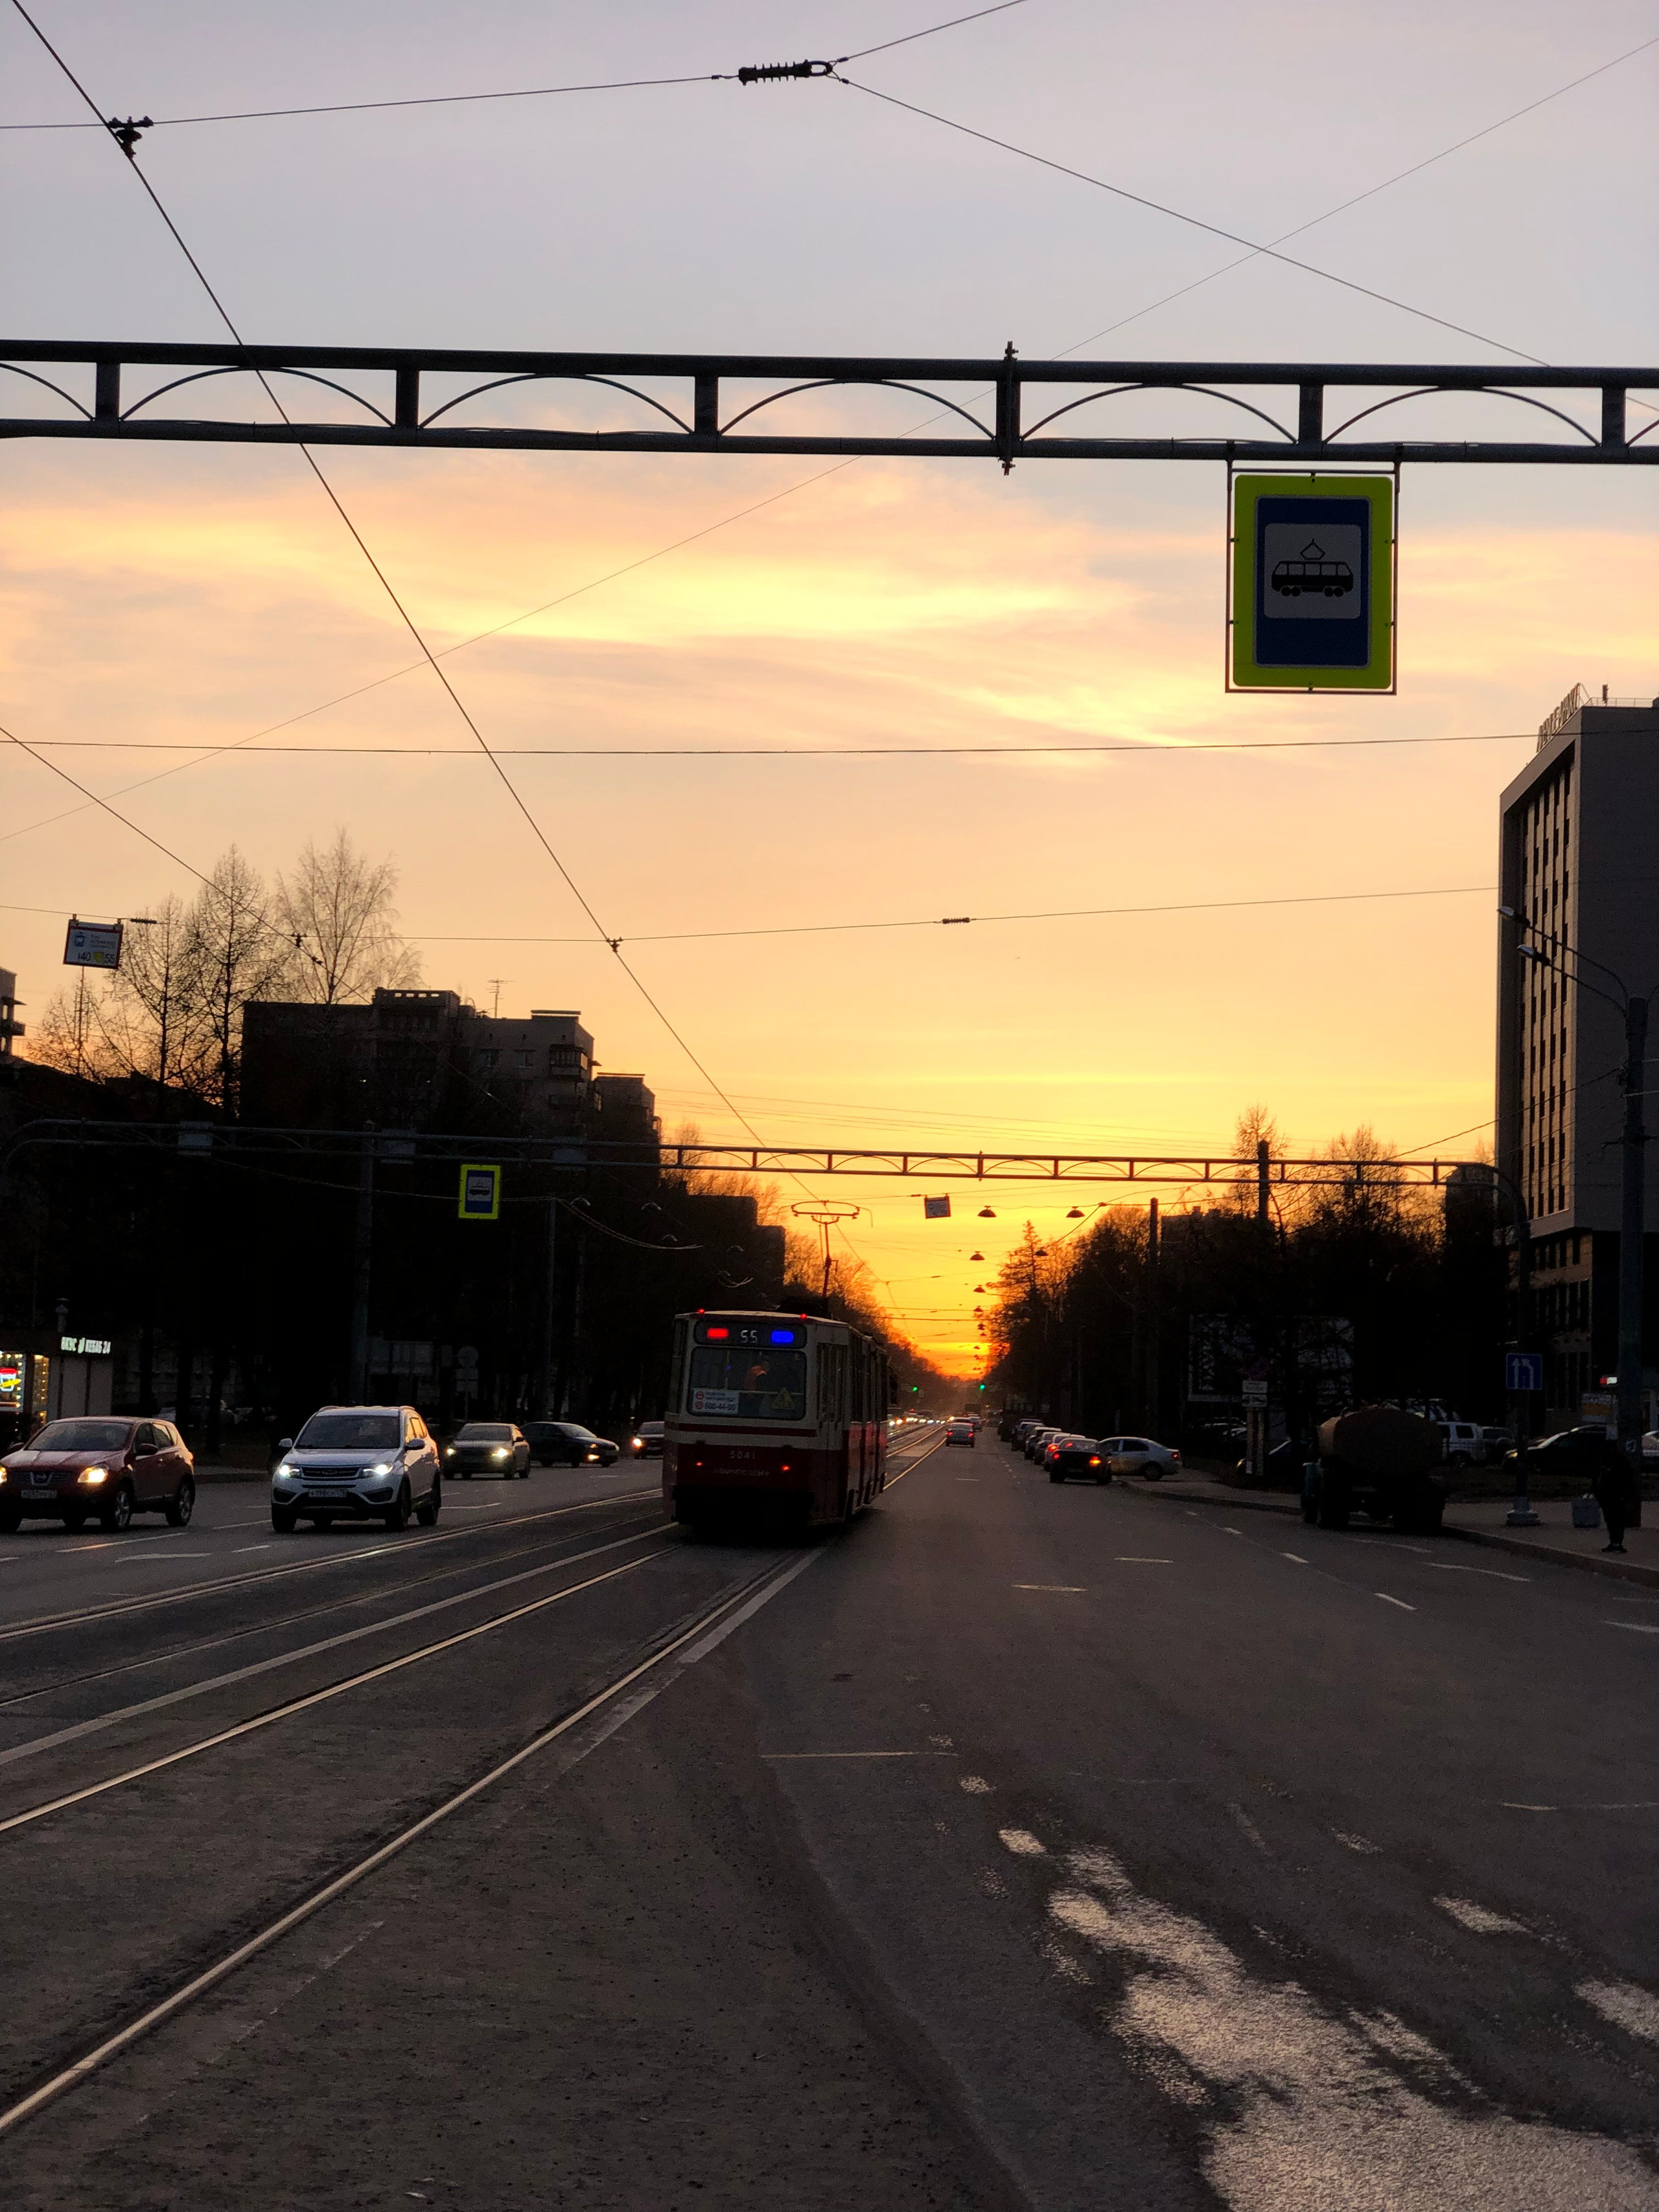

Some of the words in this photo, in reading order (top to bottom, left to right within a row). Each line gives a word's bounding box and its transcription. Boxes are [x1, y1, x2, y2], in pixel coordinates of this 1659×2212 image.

[105, 954, 115, 963] 55
[740, 1329, 758, 1344] 55
[730, 1450, 756, 1460] 5041
